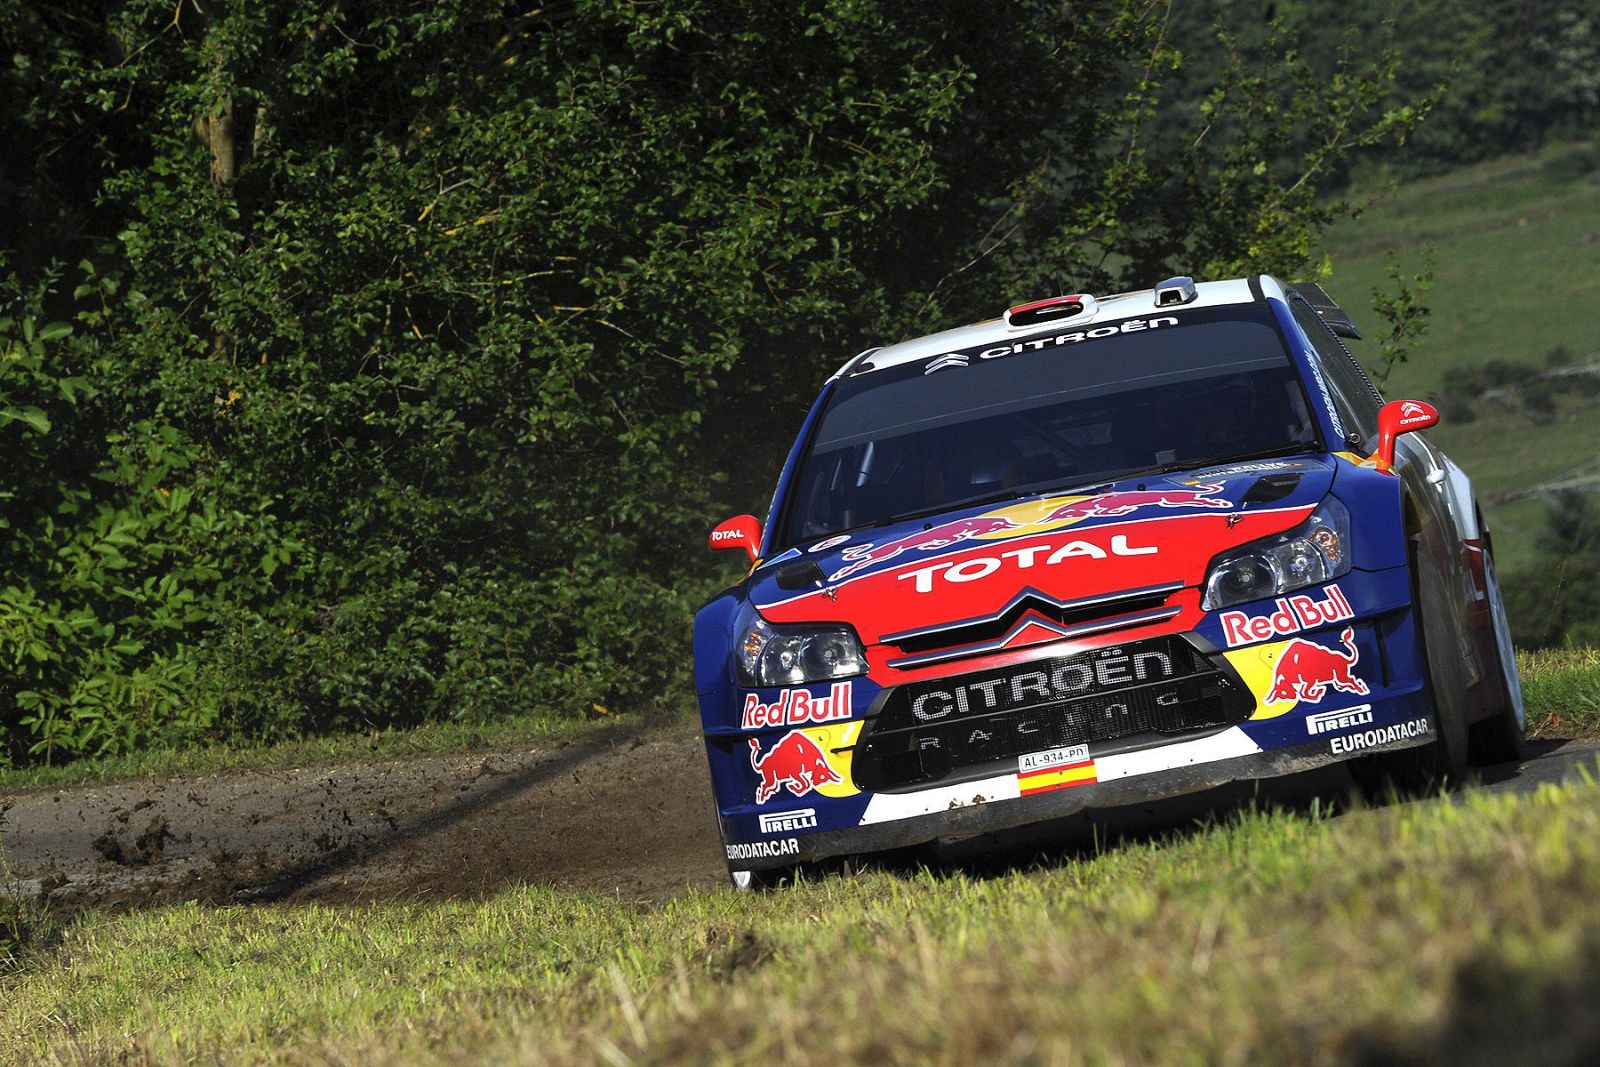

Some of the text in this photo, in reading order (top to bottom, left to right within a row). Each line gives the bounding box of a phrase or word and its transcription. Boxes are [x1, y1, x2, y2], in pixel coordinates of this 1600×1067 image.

[711, 529, 745, 541] TOTAL
[897, 534, 1159, 593] TOTAL
[1219, 583, 1356, 648] Red Bull
[741, 680, 853, 730] Red Bull
[1305, 703, 1374, 736] PIRELLI
[1329, 717, 1429, 754] EURODATACAR
[758, 807, 818, 834] PIRELLI
[726, 837, 800, 860] EURODATACAR
